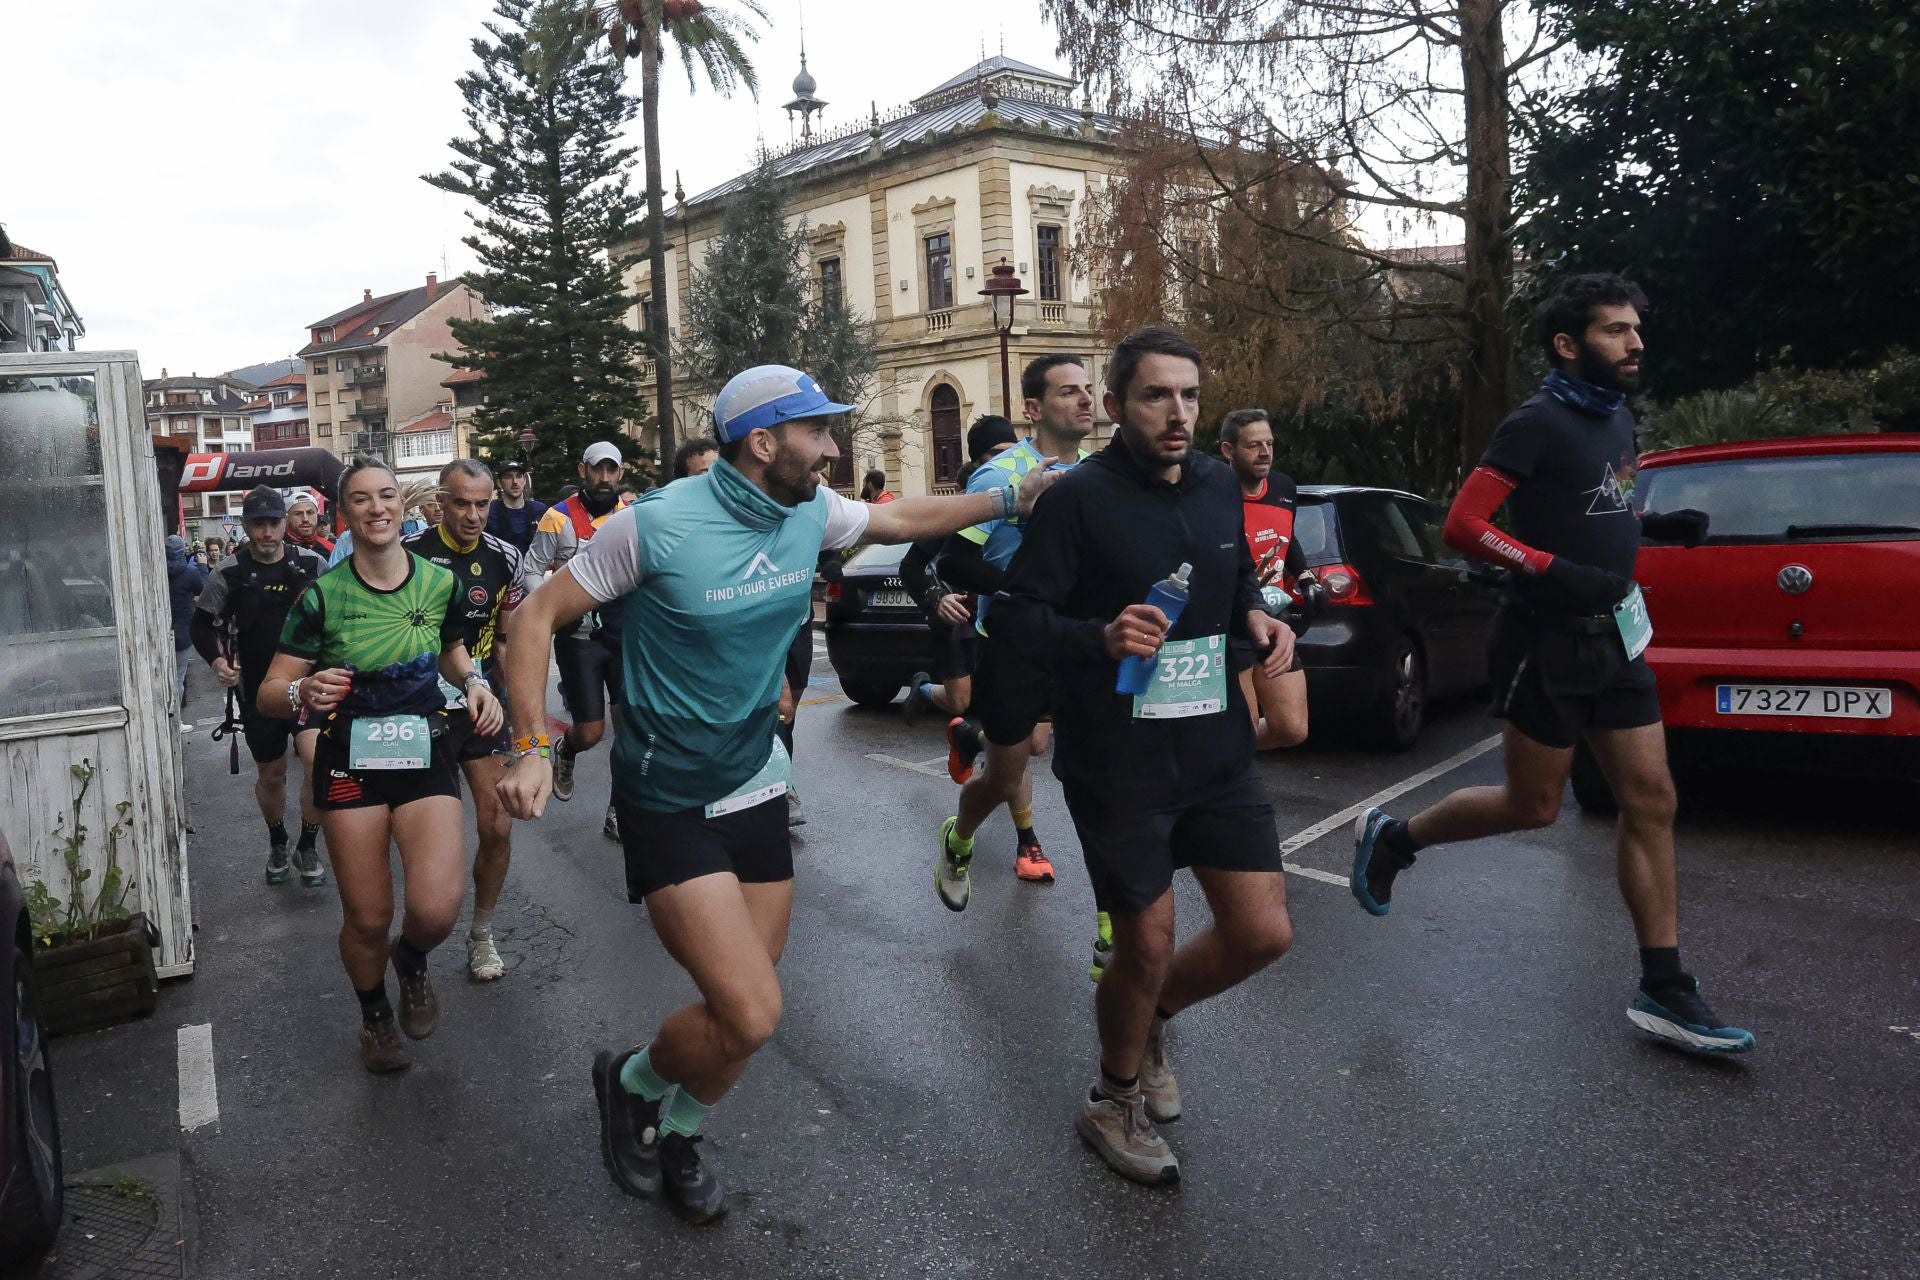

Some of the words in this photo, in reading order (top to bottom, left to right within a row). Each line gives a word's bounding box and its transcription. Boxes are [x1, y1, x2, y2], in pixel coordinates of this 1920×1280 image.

[1479, 530, 1527, 564] VILLACABRA
[705, 586, 735, 602] FIND
[736, 579, 767, 597] YOUR
[768, 567, 810, 590] EVEREST
[875, 592, 903, 605] 9830
[1158, 653, 1210, 682] 322
[1177, 679, 1202, 689] MALGA
[1736, 688, 1811, 712] 7327
[1823, 689, 1882, 715] DPX
[367, 721, 415, 741] 296
